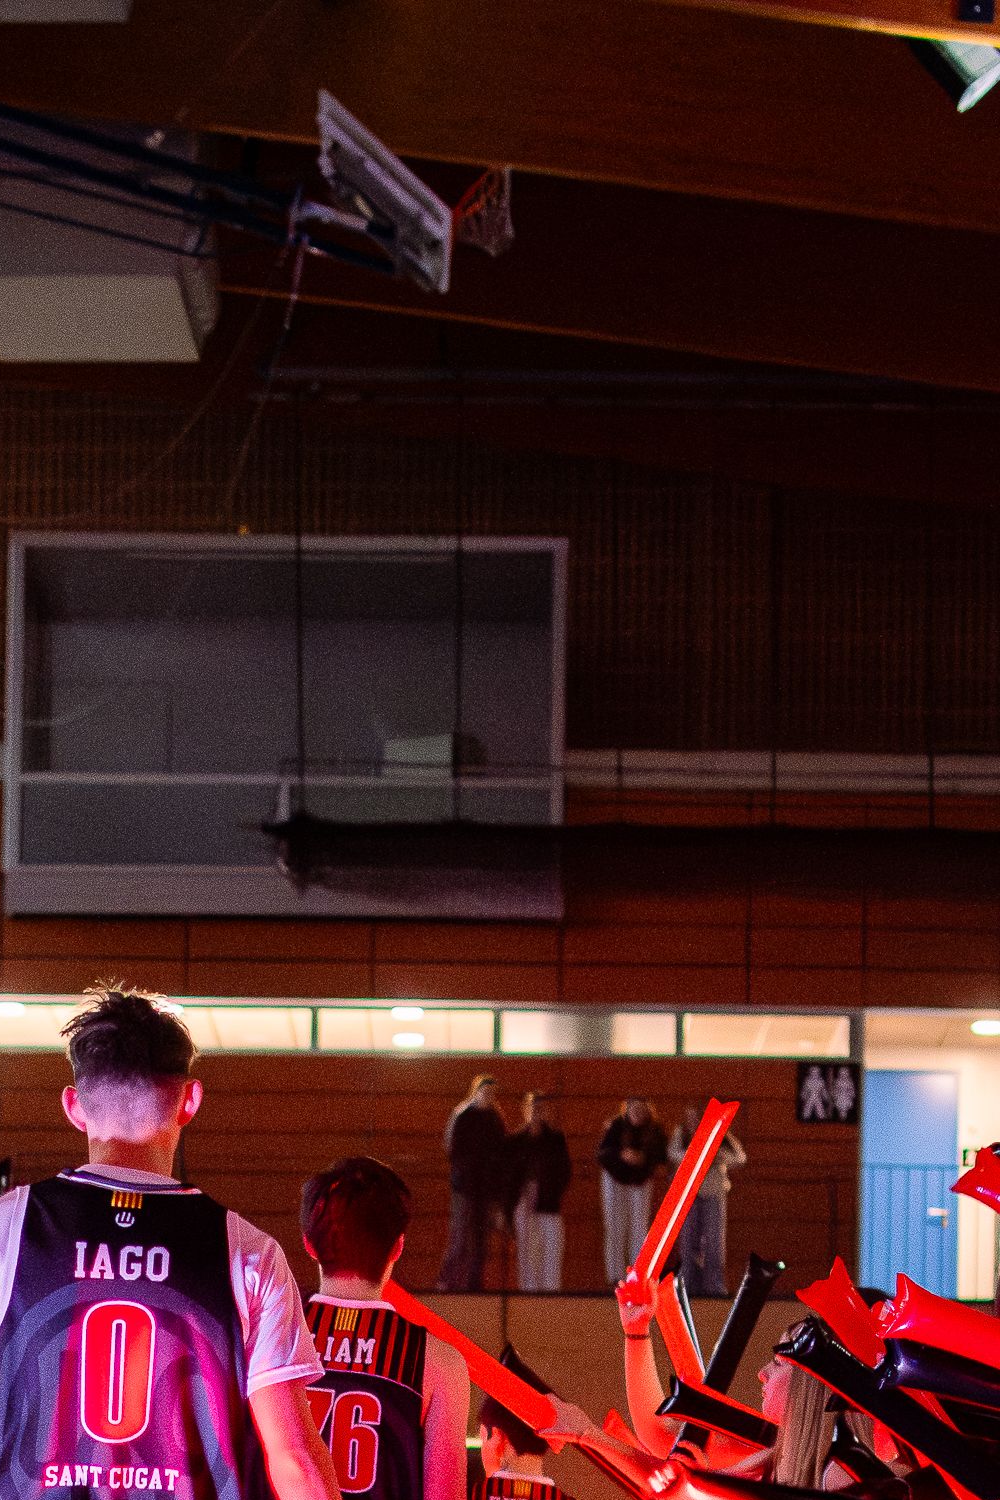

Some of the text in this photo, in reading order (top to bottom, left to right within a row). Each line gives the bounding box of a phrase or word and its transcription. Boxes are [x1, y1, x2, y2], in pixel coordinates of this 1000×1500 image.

[74, 1241, 170, 1282] IAGO
[311, 1332, 376, 1365] IAM
[80, 1300, 157, 1444] 0
[44, 1464, 180, 1491] SANT CUGAT
